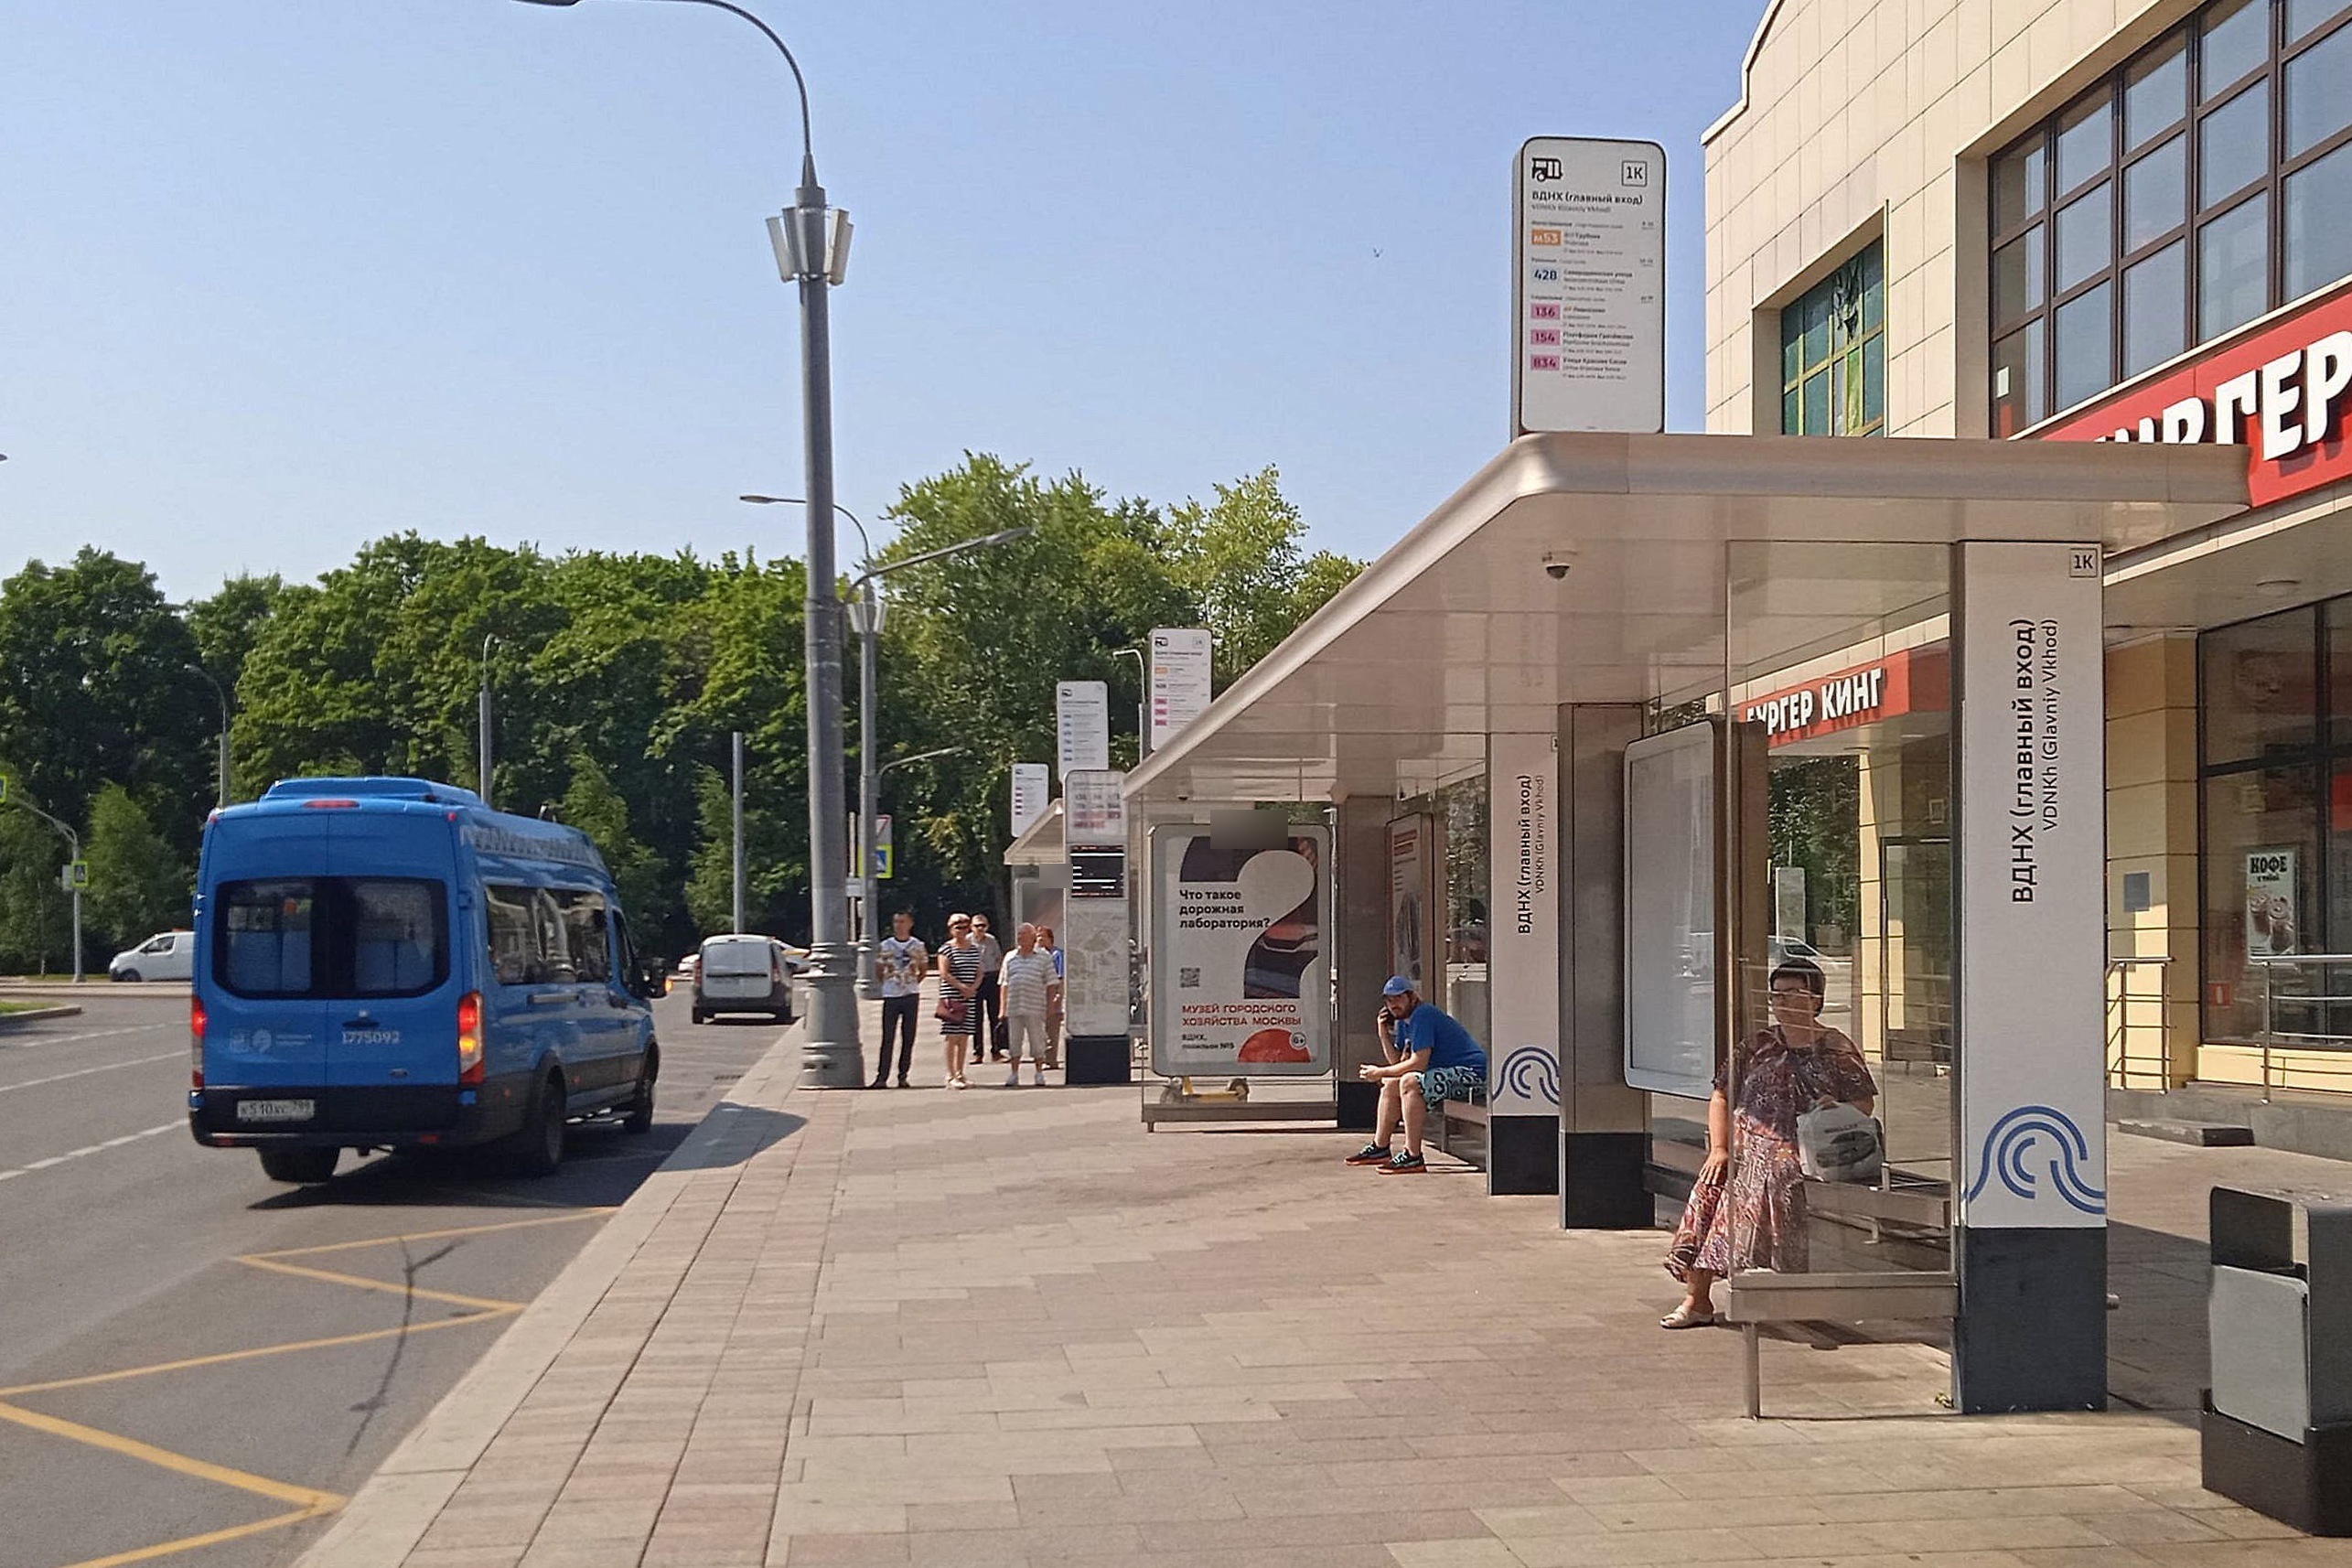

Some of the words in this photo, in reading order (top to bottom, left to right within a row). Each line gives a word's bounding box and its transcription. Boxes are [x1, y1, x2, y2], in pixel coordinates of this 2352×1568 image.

[1626, 166, 1644, 179] 1К
[1531, 189, 1563, 202] ВДНХ
[1565, 192, 1613, 205] (главный
[1615, 194, 1644, 206] вход)
[1533, 269, 1558, 281] 428
[1535, 306, 1556, 317] 136
[1535, 332, 1556, 343] 154
[2093, 331, 2352, 462] РГЕР
[2073, 554, 2094, 570] 1К
[2008, 618, 2036, 690] вход)
[2041, 618, 2058, 683] Vkhod)
[1820, 667, 1883, 722] КИНГ
[2041, 687, 2061, 760] (Glavniy
[2009, 698, 2035, 817] (главный
[1517, 775, 1532, 815] вход)
[1535, 775, 1544, 812] Vkhod)
[2040, 766, 2058, 832] VDNKh
[1517, 819, 1532, 886] (главный
[1535, 814, 1546, 854] (Glavniy
[1535, 855, 1544, 895] VDNKh
[2011, 824, 2038, 903] ВДНХ
[1179, 888, 1203, 900] Что
[1205, 891, 1242, 900] такое
[1179, 906, 1244, 916] дорожная
[1518, 889, 1533, 934] ВДНХ
[1179, 918, 1271, 930] лаборатория?
[1181, 1015, 1248, 1026] ХОЗЯЙСТВА
[1251, 1016, 1302, 1026] МОСКВЫ
[1182, 1004, 1220, 1014] МУЗЕЙ
[1223, 1004, 1297, 1014] ГОРОДСКОГО
